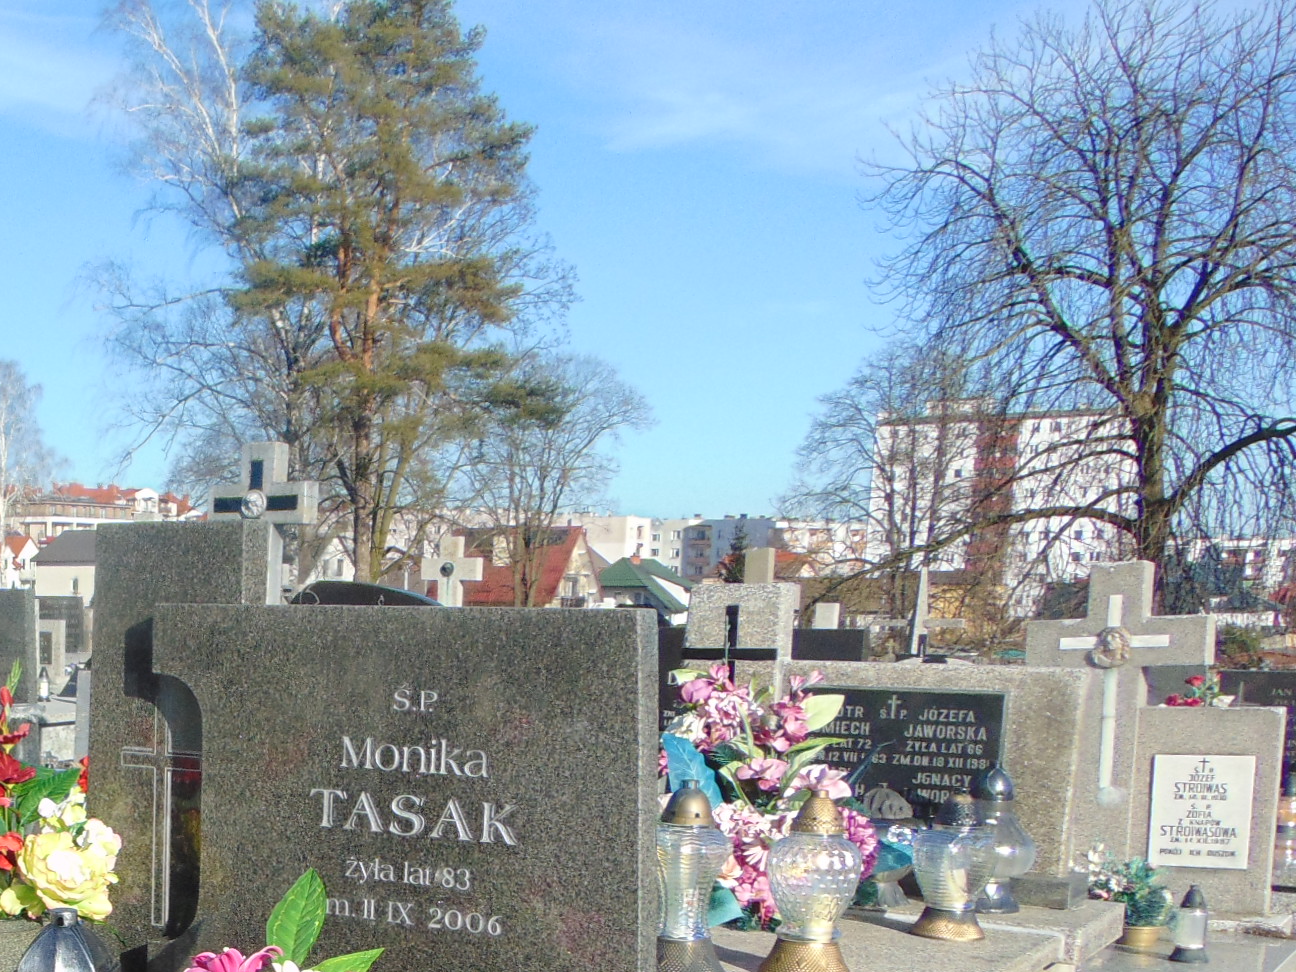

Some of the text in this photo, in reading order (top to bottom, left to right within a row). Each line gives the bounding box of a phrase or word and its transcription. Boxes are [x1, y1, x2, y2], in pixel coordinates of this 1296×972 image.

[919, 706, 976, 723] JÓZEFA
[818, 720, 871, 736] MIECH
[904, 724, 988, 741] JAWORSKA
[857, 738, 872, 749] 72
[941, 742, 964, 755] LAT
[340, 735, 489, 779] Monika
[309, 787, 518, 847] TASAK
[1186, 809, 1212, 819] ZOFIA
[403, 861, 431, 886] lat
[441, 868, 471, 891] 83
[325, 897, 356, 918] m.
[428, 907, 503, 936] 2006
